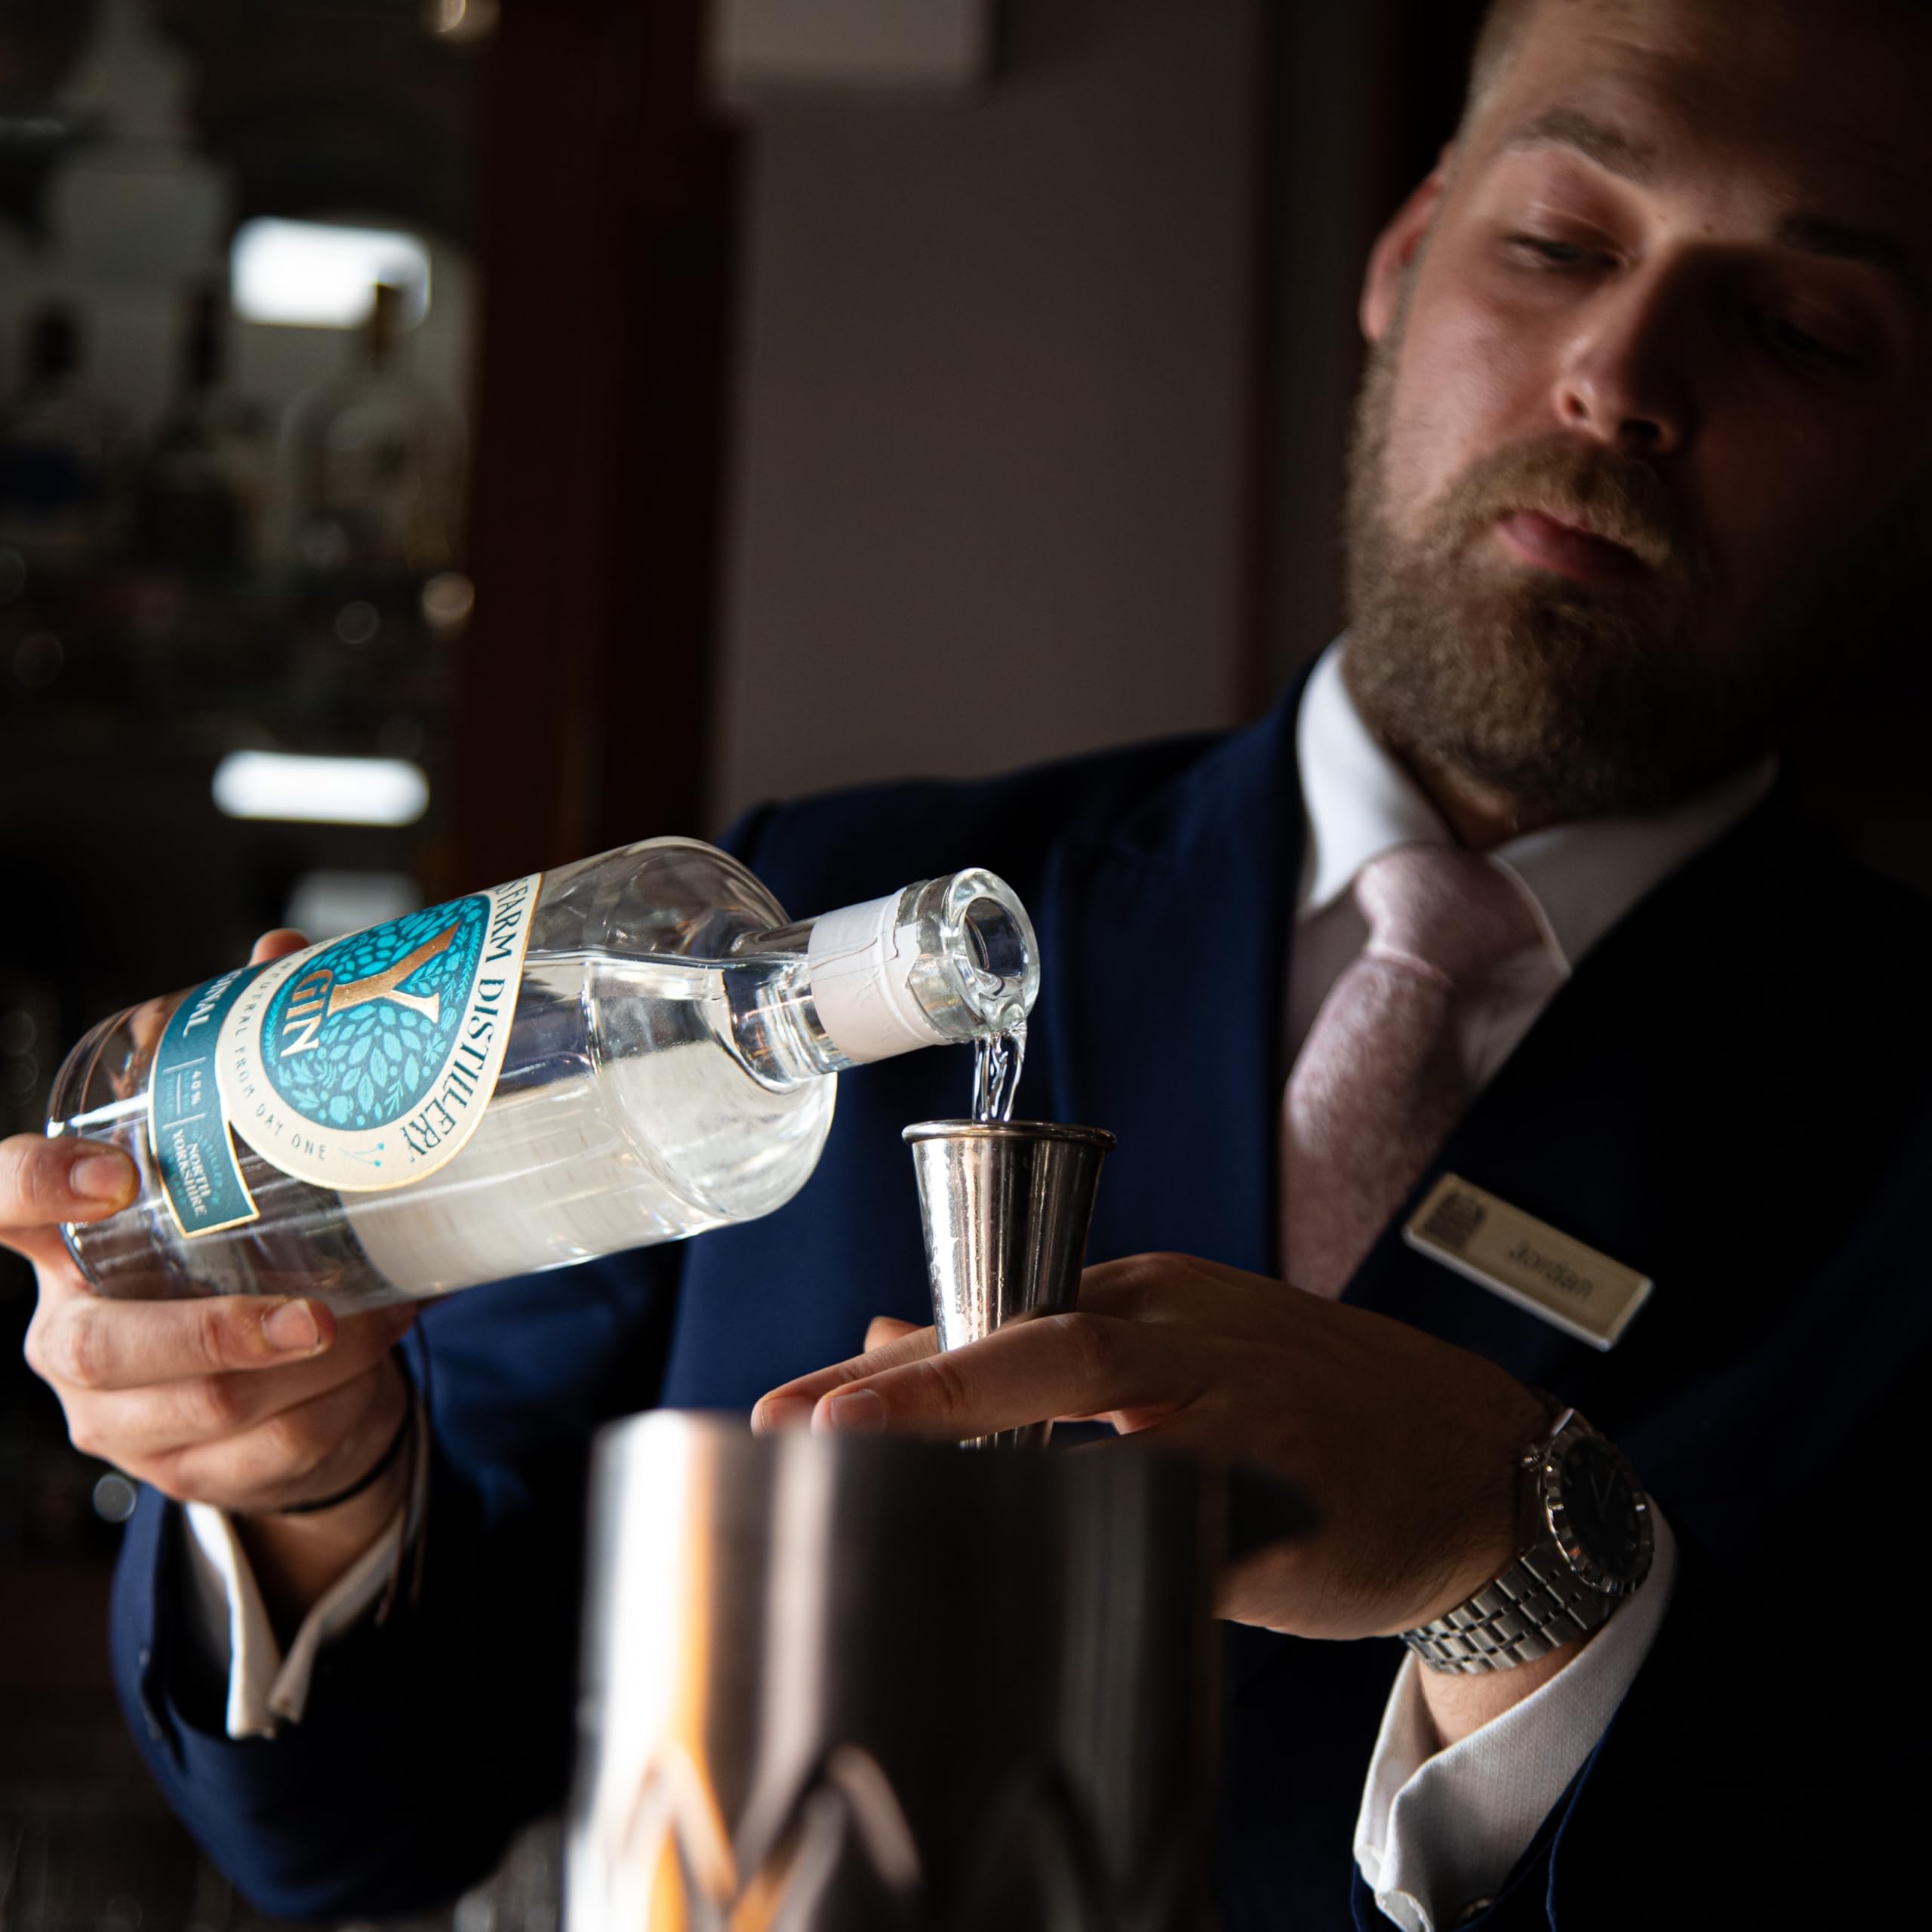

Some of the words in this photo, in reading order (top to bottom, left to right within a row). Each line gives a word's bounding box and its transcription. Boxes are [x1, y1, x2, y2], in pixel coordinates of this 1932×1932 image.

[485, 884, 528, 963] FARM
[182, 970, 242, 1038] GINAL
[235, 961, 293, 1037] NEUTRAL
[280, 969, 334, 1057] GIN
[191, 1070, 202, 1106] 40%
[234, 1045, 255, 1099] FROM
[400, 978, 506, 1162] DISTILLERY
[255, 1102, 284, 1135] DAY
[291, 1133, 327, 1160] ONE
[172, 1128, 208, 1218] YORKSHIRE
[186, 1143, 212, 1197] NORTH
[1508, 1238, 1594, 1302] Jordan
